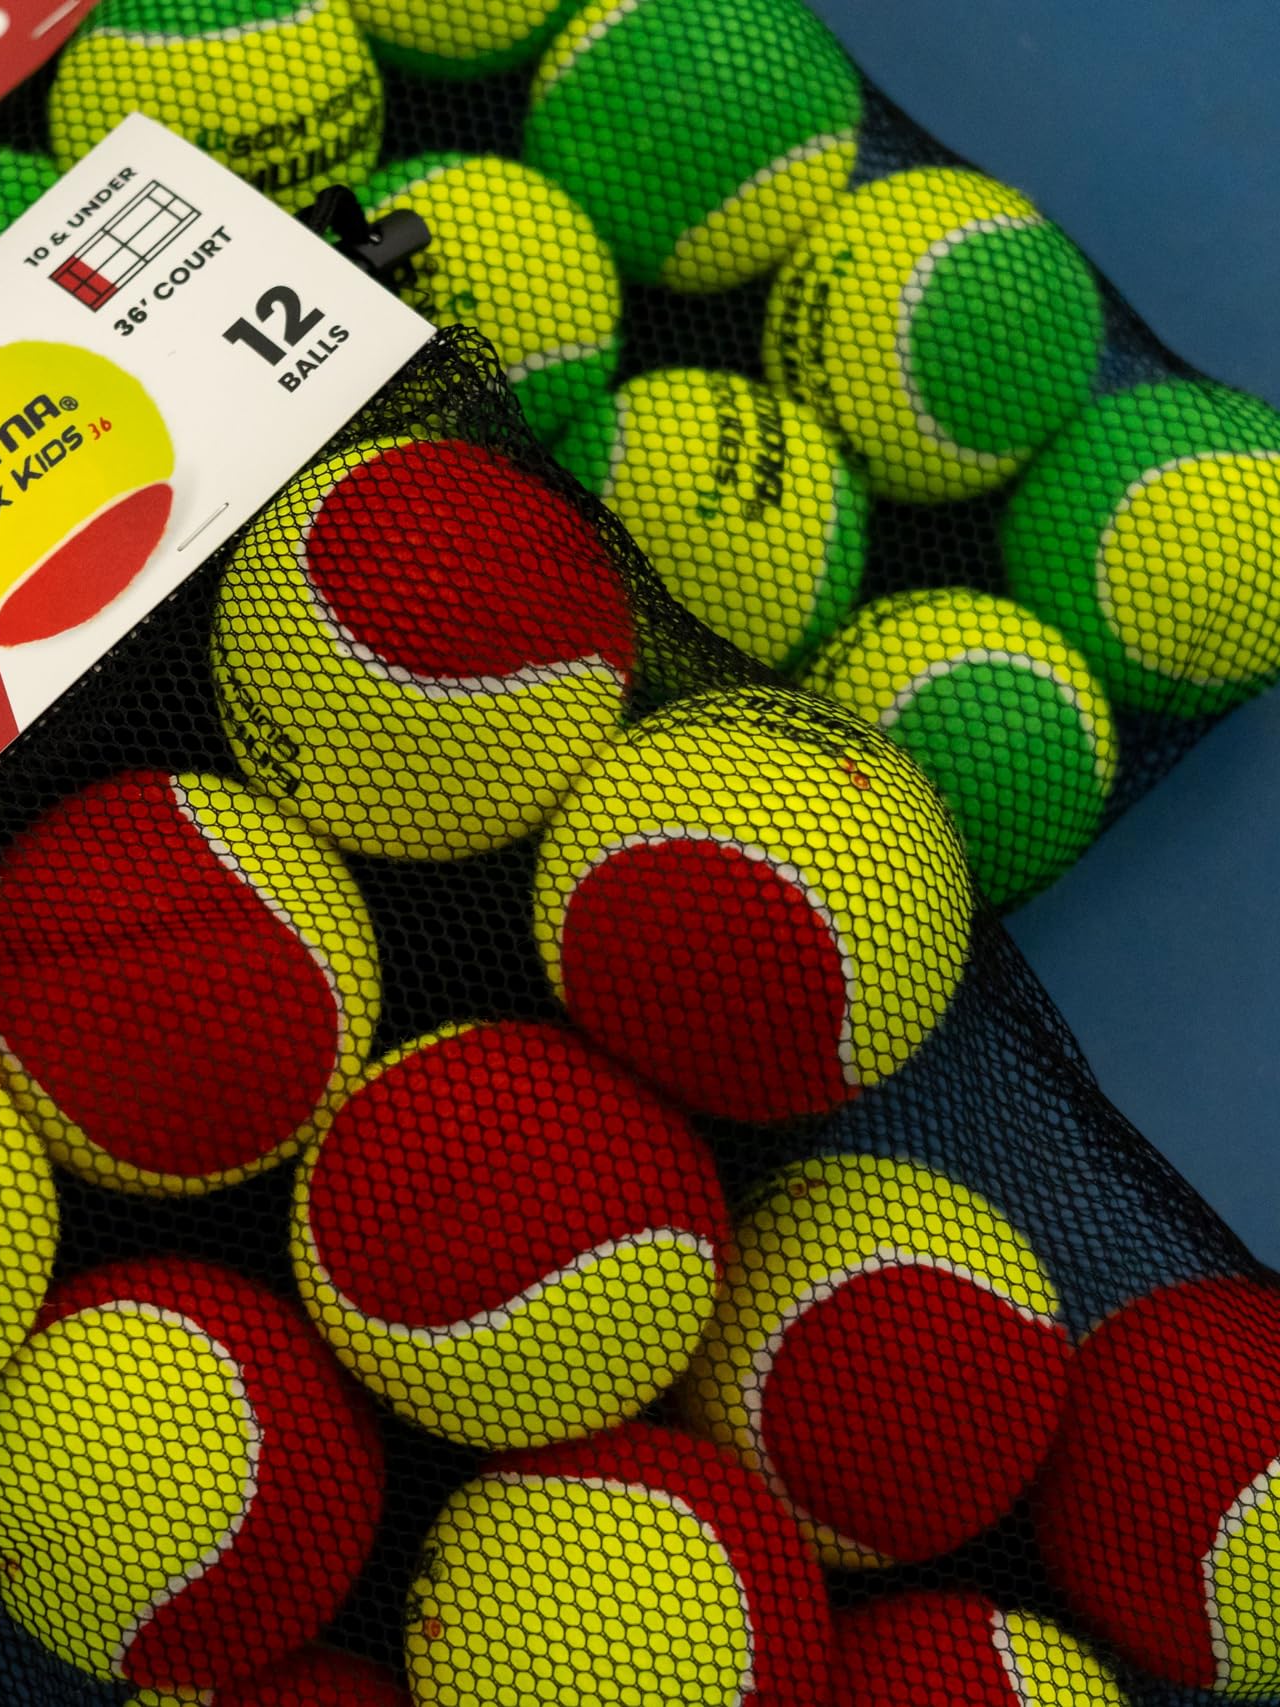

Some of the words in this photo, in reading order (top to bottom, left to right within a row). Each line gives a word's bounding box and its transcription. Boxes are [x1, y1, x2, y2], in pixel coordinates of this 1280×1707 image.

[23, 246, 50, 267] 10
[50, 231, 71, 246] &
[66, 166, 138, 229] UNDER
[153, 225, 233, 301] COURT
[222, 285, 326, 366] 12
[277, 324, 350, 393] BALLS
[10, 424, 84, 492] KIDS
[87, 415, 113, 441] 36
